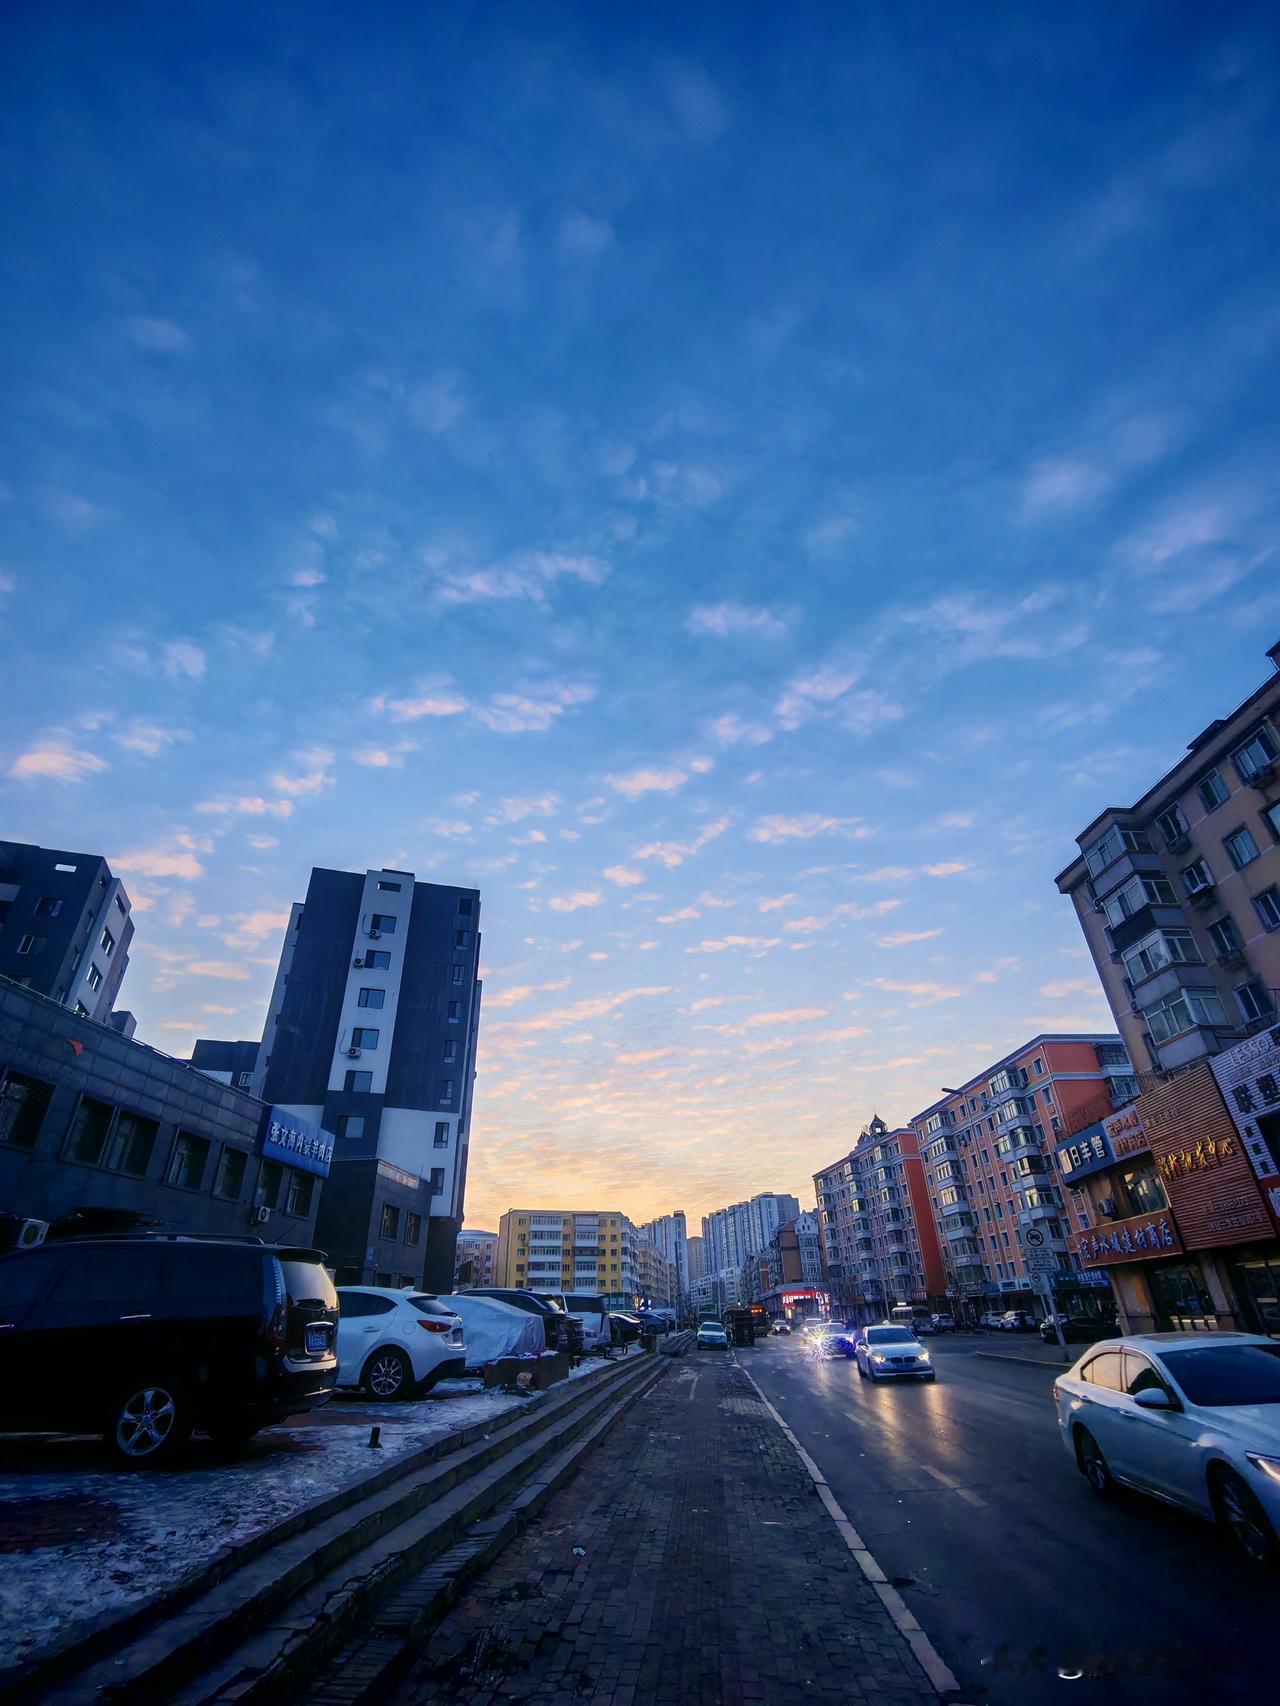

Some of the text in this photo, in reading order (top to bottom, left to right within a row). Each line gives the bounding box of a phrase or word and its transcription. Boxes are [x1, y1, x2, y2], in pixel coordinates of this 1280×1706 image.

[1229, 1038, 1270, 1066] LESSO
[1069, 1134, 1105, 1166] 日丰管
